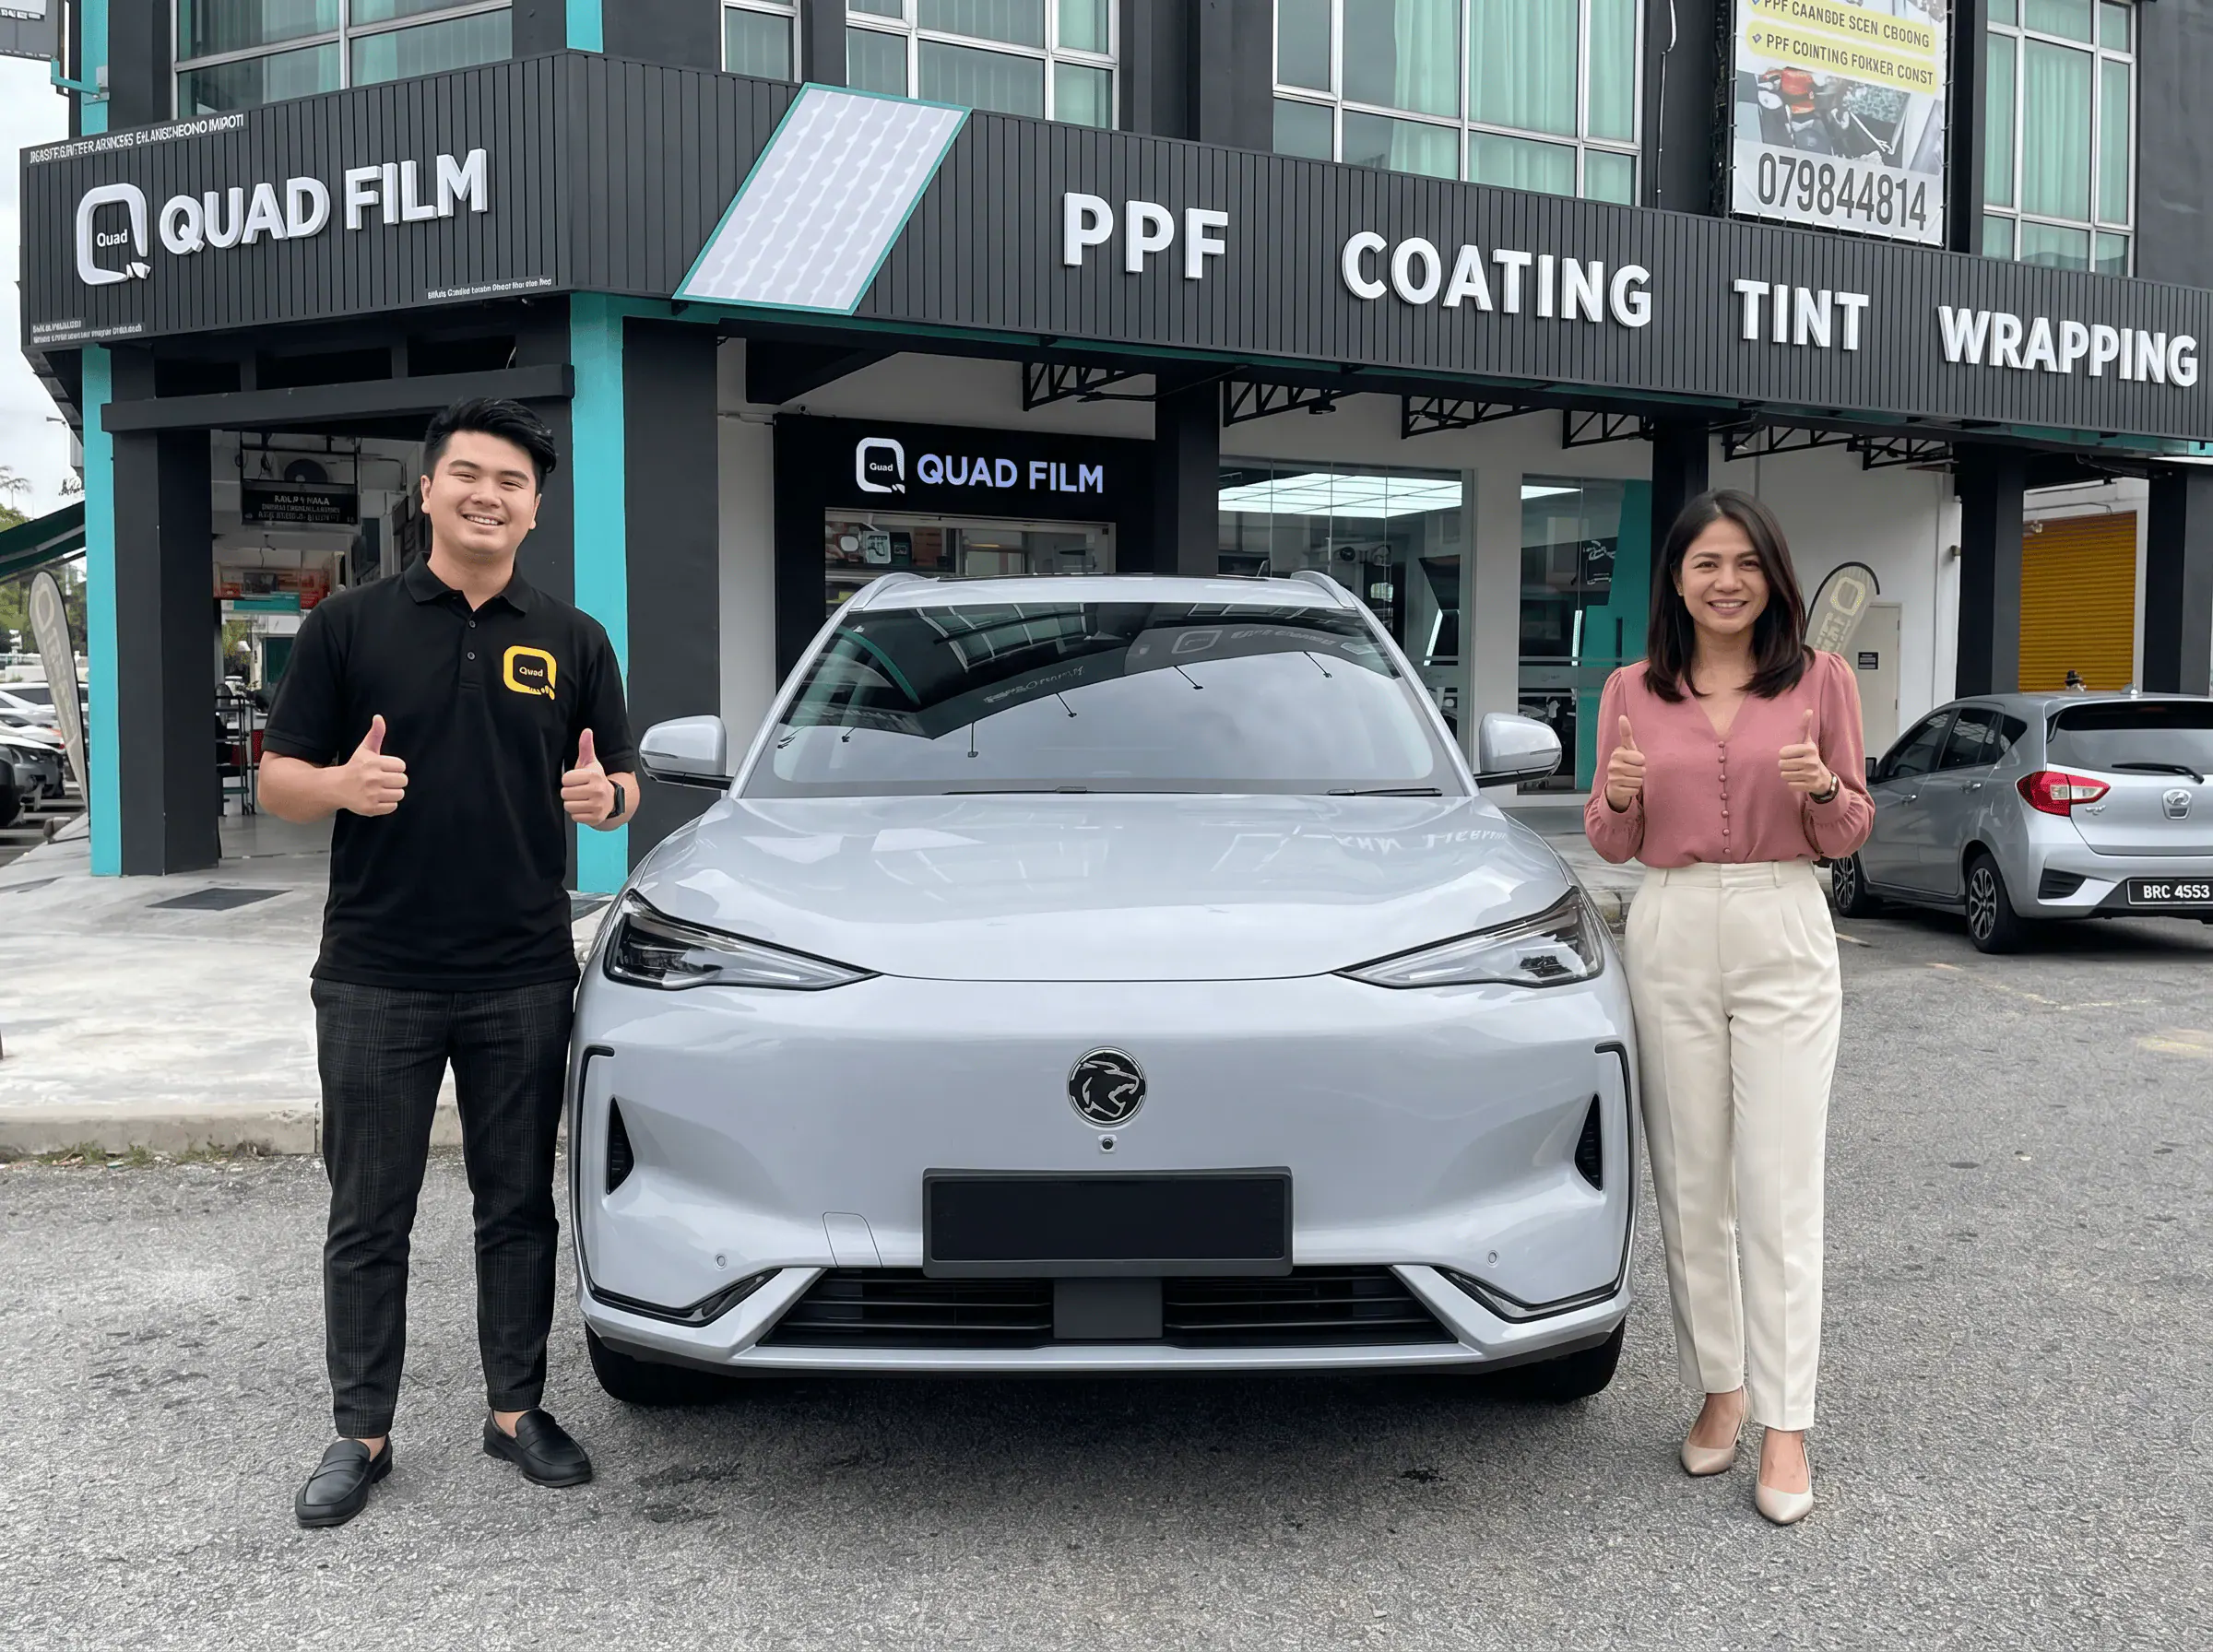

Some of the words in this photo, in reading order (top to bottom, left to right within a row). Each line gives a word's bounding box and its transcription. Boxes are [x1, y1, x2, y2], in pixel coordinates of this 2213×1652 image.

[1849, 15, 1878, 36] SCEN
[1766, 33, 1790, 52] PPF
[1793, 40, 1848, 66] COINTING
[1897, 65, 1934, 86] CONST
[159, 176, 331, 255] QUAD
[345, 148, 489, 230] FILM
[1757, 152, 1927, 231] 079844814
[96, 229, 128, 248] Quad
[1063, 192, 1229, 279] PPF
[1342, 230, 1652, 328] COATING
[1734, 278, 1870, 351] TINT
[1937, 305, 2198, 387] WRAPPING
[917, 454, 1018, 489] QUAD
[1028, 460, 1104, 494] FILM
[2143, 885, 2172, 899] BRC
[2174, 884, 2210, 899] 4553
